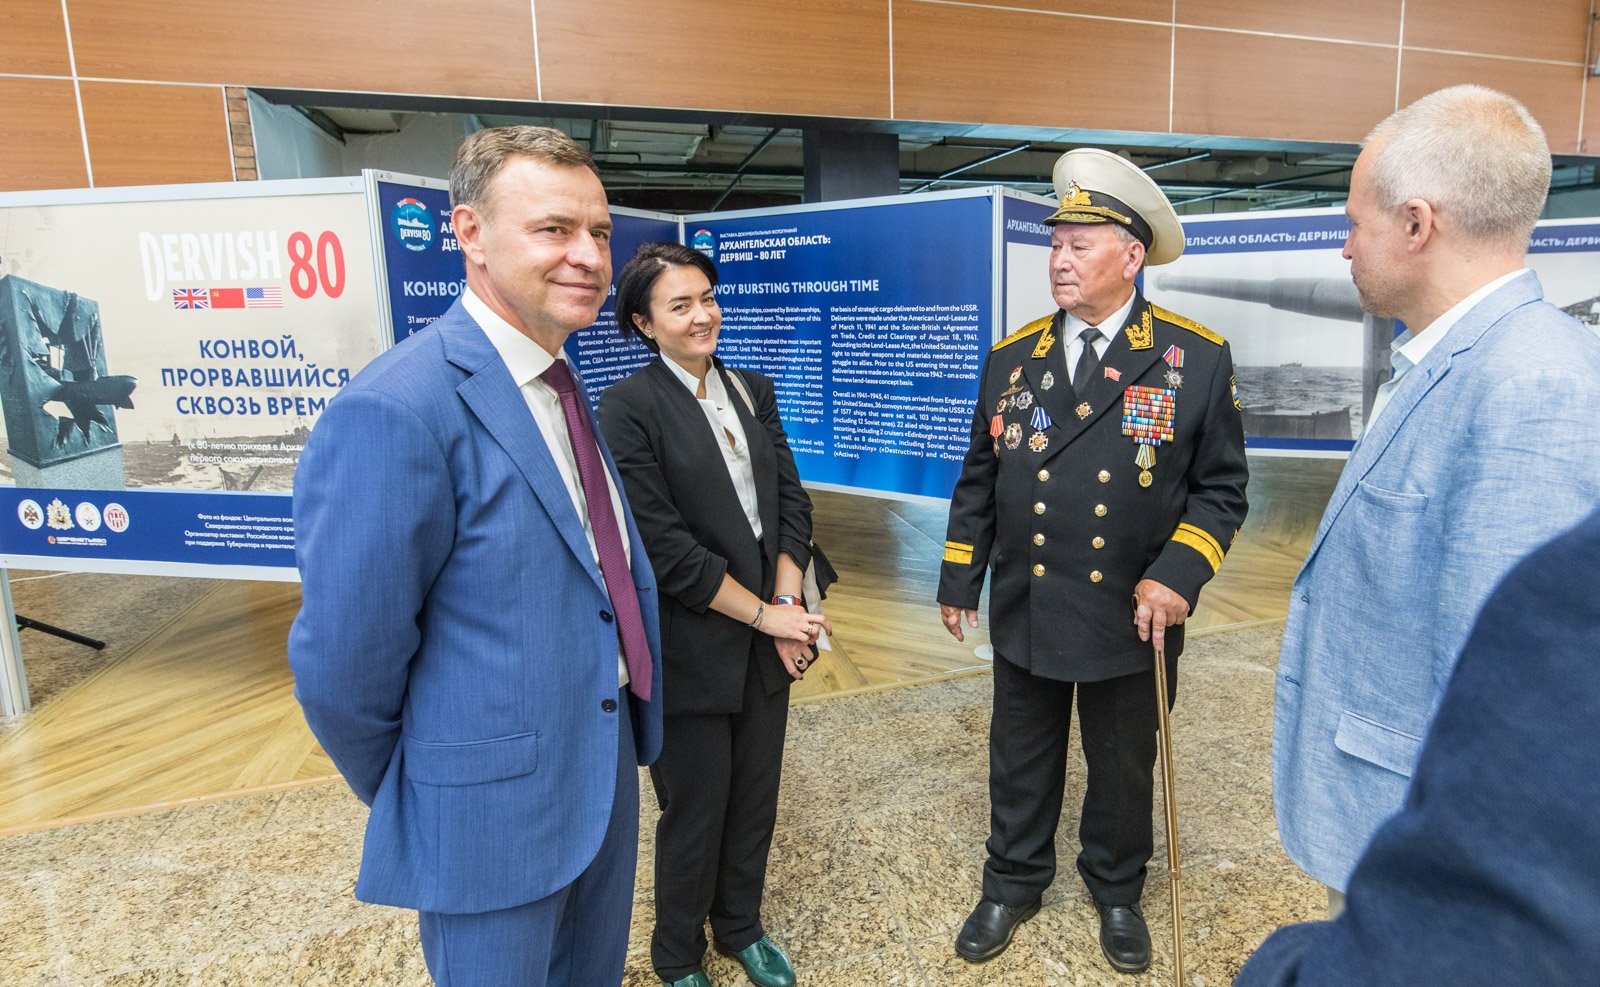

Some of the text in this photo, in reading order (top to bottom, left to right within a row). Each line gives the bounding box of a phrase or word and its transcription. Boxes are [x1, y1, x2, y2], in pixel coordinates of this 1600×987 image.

[440, 222, 453, 234] АР
[422, 230, 431, 241] 80
[1185, 230, 1350, 247] ЕЛЬСКАЯ ОБЛАСТЬ: ДЕРВИШ
[719, 235, 831, 251] АРХАНГЕЛЬСКАЯ ОБЛАСТЬ:
[719, 252, 753, 264] ДЕРВИШ
[759, 251, 770, 260] 80
[770, 250, 786, 260] ЛЕТ
[138, 230, 346, 301] DERVISH 80
[739, 282, 790, 294] BURSTING
[791, 281, 848, 293] THROUGH
[850, 279, 879, 292] TIME
[407, 315, 415, 324] 31
[831, 314, 855, 322] Deliveries
[943, 324, 979, 332] «Agreement
[890, 333, 917, 341] Clearing»
[929, 334, 950, 342] August
[199, 335, 303, 361] КОНВОЙ,
[592, 356, 604, 364] США
[832, 350, 843, 358] right
[964, 354, 978, 362] joint
[161, 364, 350, 387] ПРОРВАВШИЙСЯ
[176, 396, 326, 415] СКВОЗЬ ВРЕМ
[833, 416, 857, 426] (including
[932, 415, 946, 423] ships
[280, 442, 304, 453] Архан
[868, 437, 897, 446] destroyers,
[899, 440, 925, 449] including
[926, 442, 945, 450] Soviet
[834, 451, 860, 460] («Active»).
